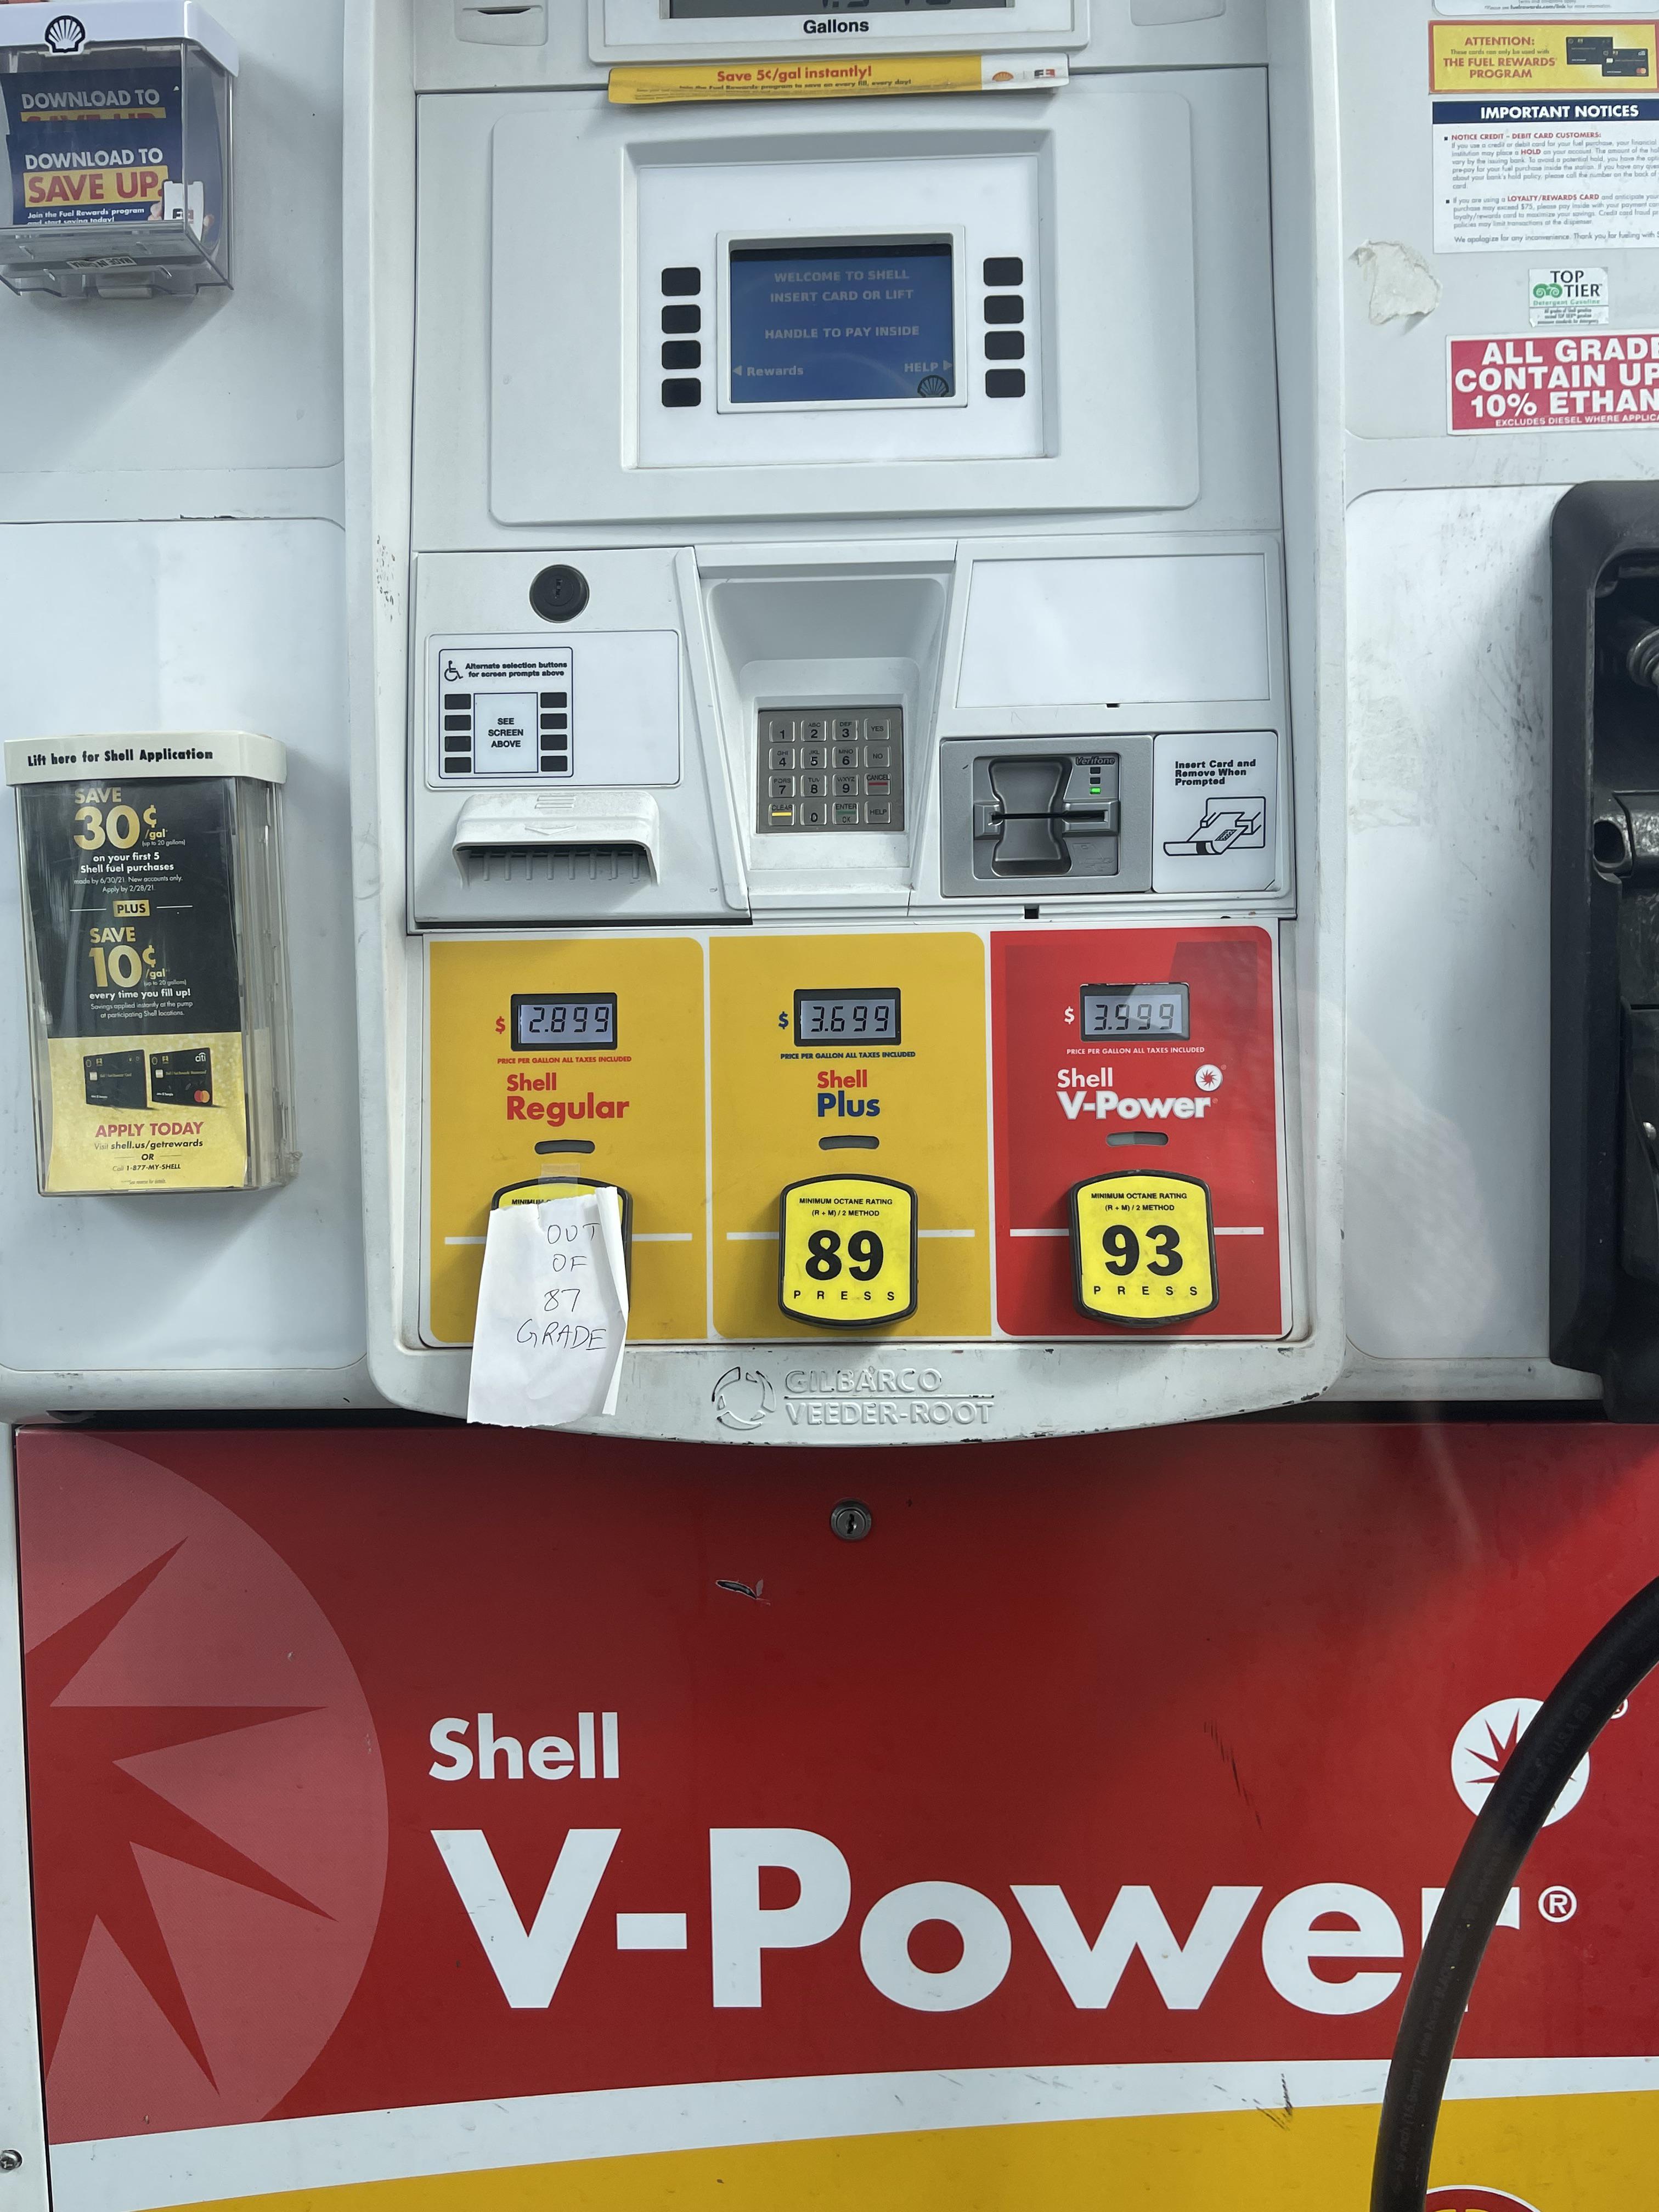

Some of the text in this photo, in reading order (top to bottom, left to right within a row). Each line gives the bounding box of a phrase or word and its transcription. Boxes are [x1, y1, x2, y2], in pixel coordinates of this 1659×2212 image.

[803, 19, 869, 35] Gallons
[1465, 37, 1534, 46] ATTENTION:
[1443, 58, 1555, 67] THE FUEL REWARDS
[718, 65, 872, 83] Save 5¢/gal instantly!
[1470, 69, 1533, 78] PROGRAM
[22, 89, 160, 109] DOWNLOAD TO
[1481, 105, 1639, 119] IMPORTANT NOTICES
[25, 148, 163, 169] DOWNLOAD TO
[29, 173, 104, 204] SAVE
[111, 207, 144, 217] program
[775, 269, 910, 282] WELCOME TO SHELL
[1550, 270, 1584, 284] TOP
[770, 290, 913, 303] INSERT CARD OR LIFT
[765, 326, 919, 339] HANDLE TO PAY INSIDE
[1482, 341, 1543, 365] ALL
[747, 362, 938, 377] Rewards HELP
[1455, 364, 1605, 393] CONTAIN
[1471, 393, 1537, 418] 10%
[1496, 417, 1545, 427] EXCLUDES
[1549, 416, 1582, 425] DIESEL
[1585, 415, 1618, 424] WHERE
[780, 730, 785, 739] 1
[811, 730, 818, 738] 2
[842, 729, 849, 737] 3
[28, 748, 213, 766] Lift here for Shell Application
[779, 758, 786, 767] 4
[811, 757, 818, 766] 5
[842, 756, 850, 765] 6
[1076, 757, 1115, 765] Verifone
[1175, 761, 1206, 769] Insert
[1209, 760, 1234, 768] Card
[1175, 768, 1246, 777] Remove When
[778, 783, 850, 794] 7 8 9
[1175, 777, 1226, 787] Prompted
[75, 787, 121, 804] SAVE
[810, 812, 818, 822] 0
[108, 854, 129, 864] your
[81, 863, 174, 874] Shell fuel purchases
[117, 904, 146, 914] PLUS
[89, 927, 136, 943] SAVE
[89, 988, 191, 1001] every time you fill up!
[495, 1007, 610, 1034] $ 2.899
[778, 1006, 889, 1032] $ 3.699
[1064, 1006, 1074, 1024] $
[507, 1073, 556, 1091] Shell
[817, 1069, 867, 1088] Shell
[1057, 1068, 1113, 1088] Shell
[507, 1092, 629, 1127] Regular
[817, 1091, 881, 1117] Plus
[1056, 1091, 1211, 1120] V-Power
[95, 1122, 204, 1137] APPLY TODAY
[111, 1139, 203, 1150] shell.us/getrewards
[548, 1223, 601, 1244] OUT
[805, 1230, 883, 1281] 89
[1103, 1224, 1183, 1276] 93
[552, 1254, 587, 1272] OF
[544, 1289, 580, 1312] 87
[517, 1319, 606, 1351] GRADE
[785, 1368, 943, 1393] GILBARCO
[786, 1401, 994, 1425] VEEDER-ROOT
[429, 1712, 620, 1781] Shell
